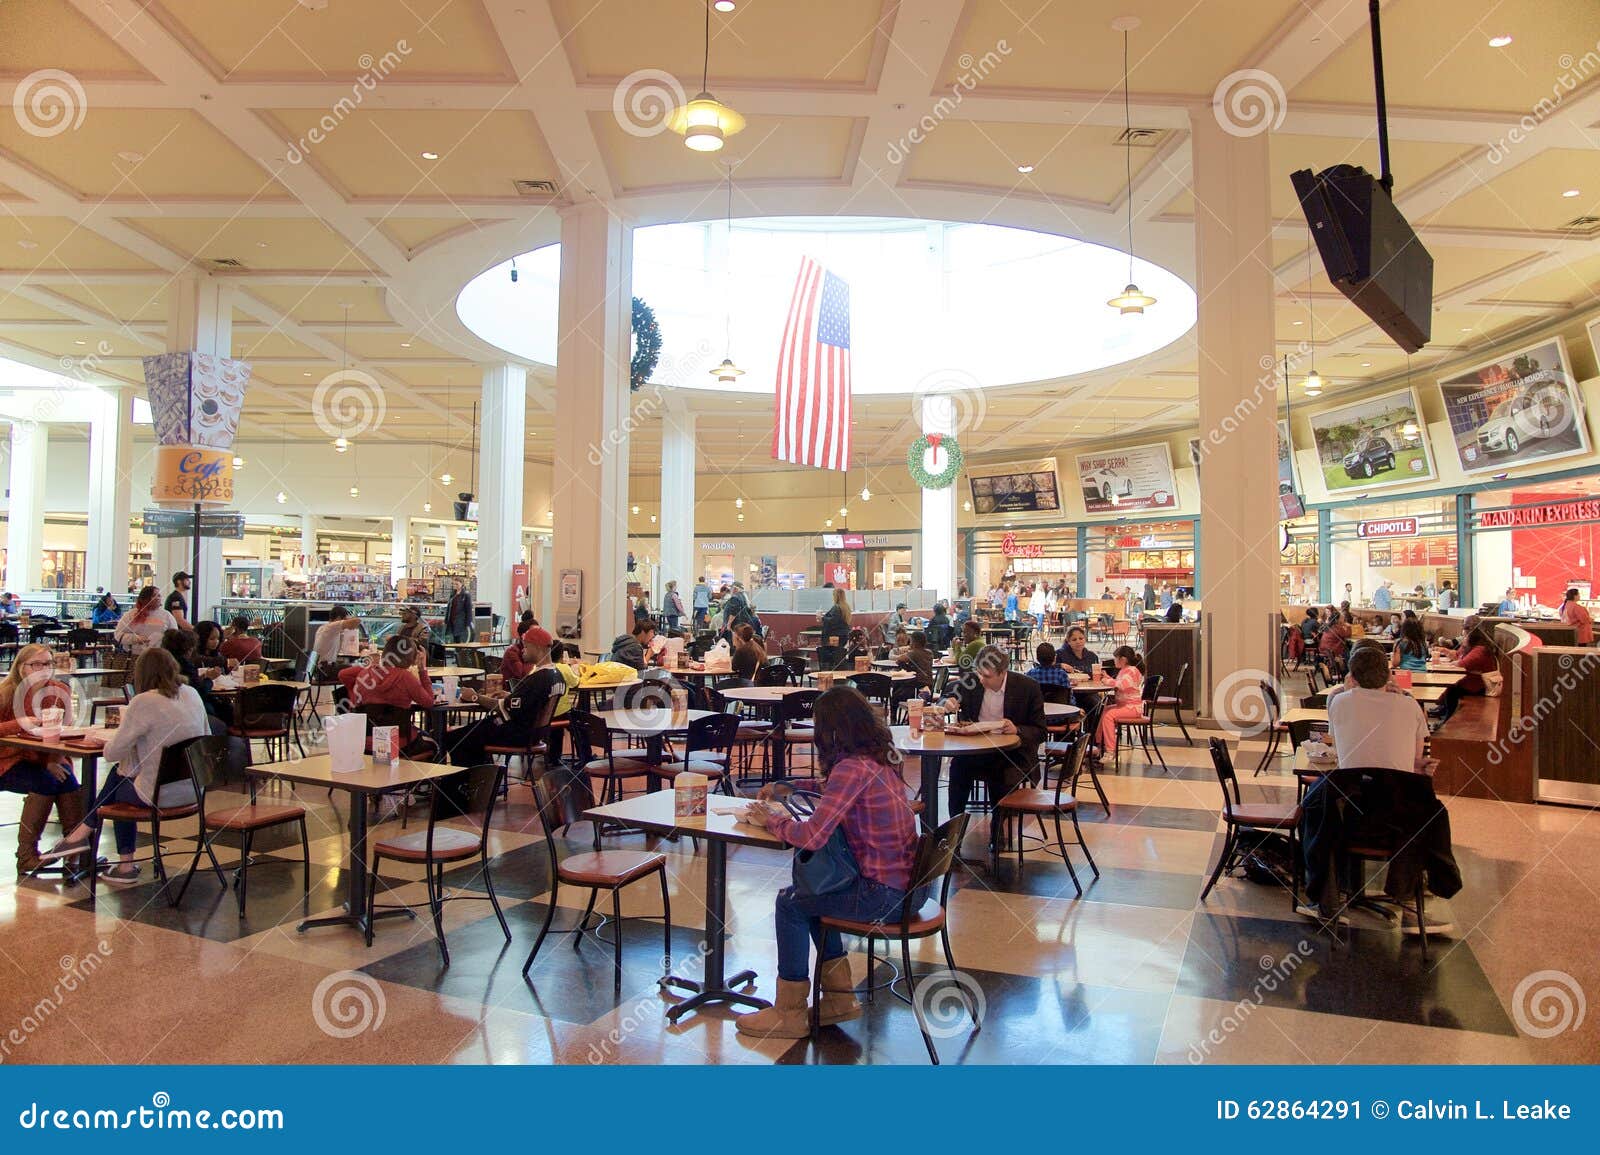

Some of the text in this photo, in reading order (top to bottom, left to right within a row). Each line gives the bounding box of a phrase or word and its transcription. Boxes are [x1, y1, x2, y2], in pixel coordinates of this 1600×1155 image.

[1481, 500, 1600, 527] MANDARIN EXPRESS
[1367, 520, 1413, 534] CHIPOTLE
